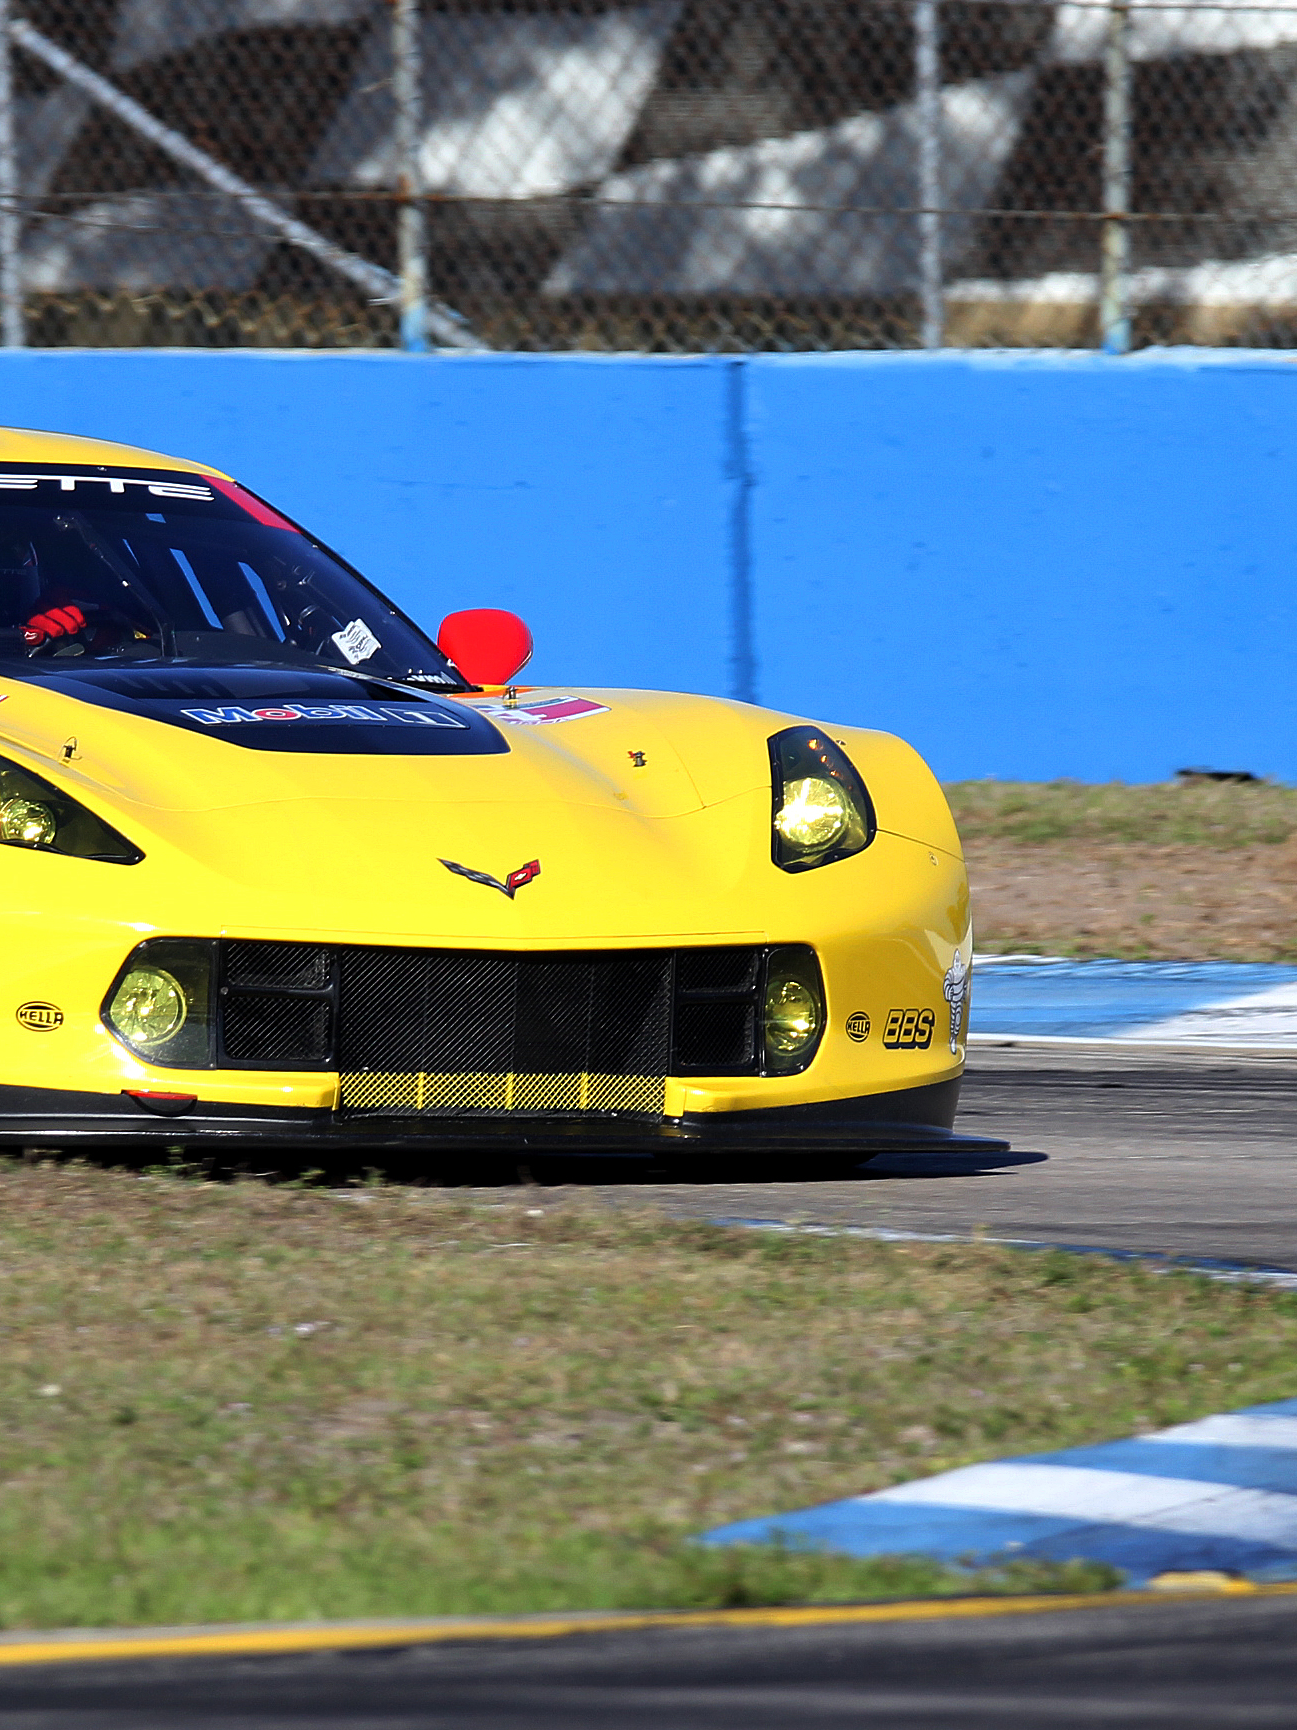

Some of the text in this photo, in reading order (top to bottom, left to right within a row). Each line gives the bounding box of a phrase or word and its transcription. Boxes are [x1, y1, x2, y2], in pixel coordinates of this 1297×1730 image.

[180, 705, 387, 725] Mobil
[19, 1010, 64, 1026] HELLA
[847, 1020, 871, 1035] HELLA
[883, 1008, 935, 1049] BBS
